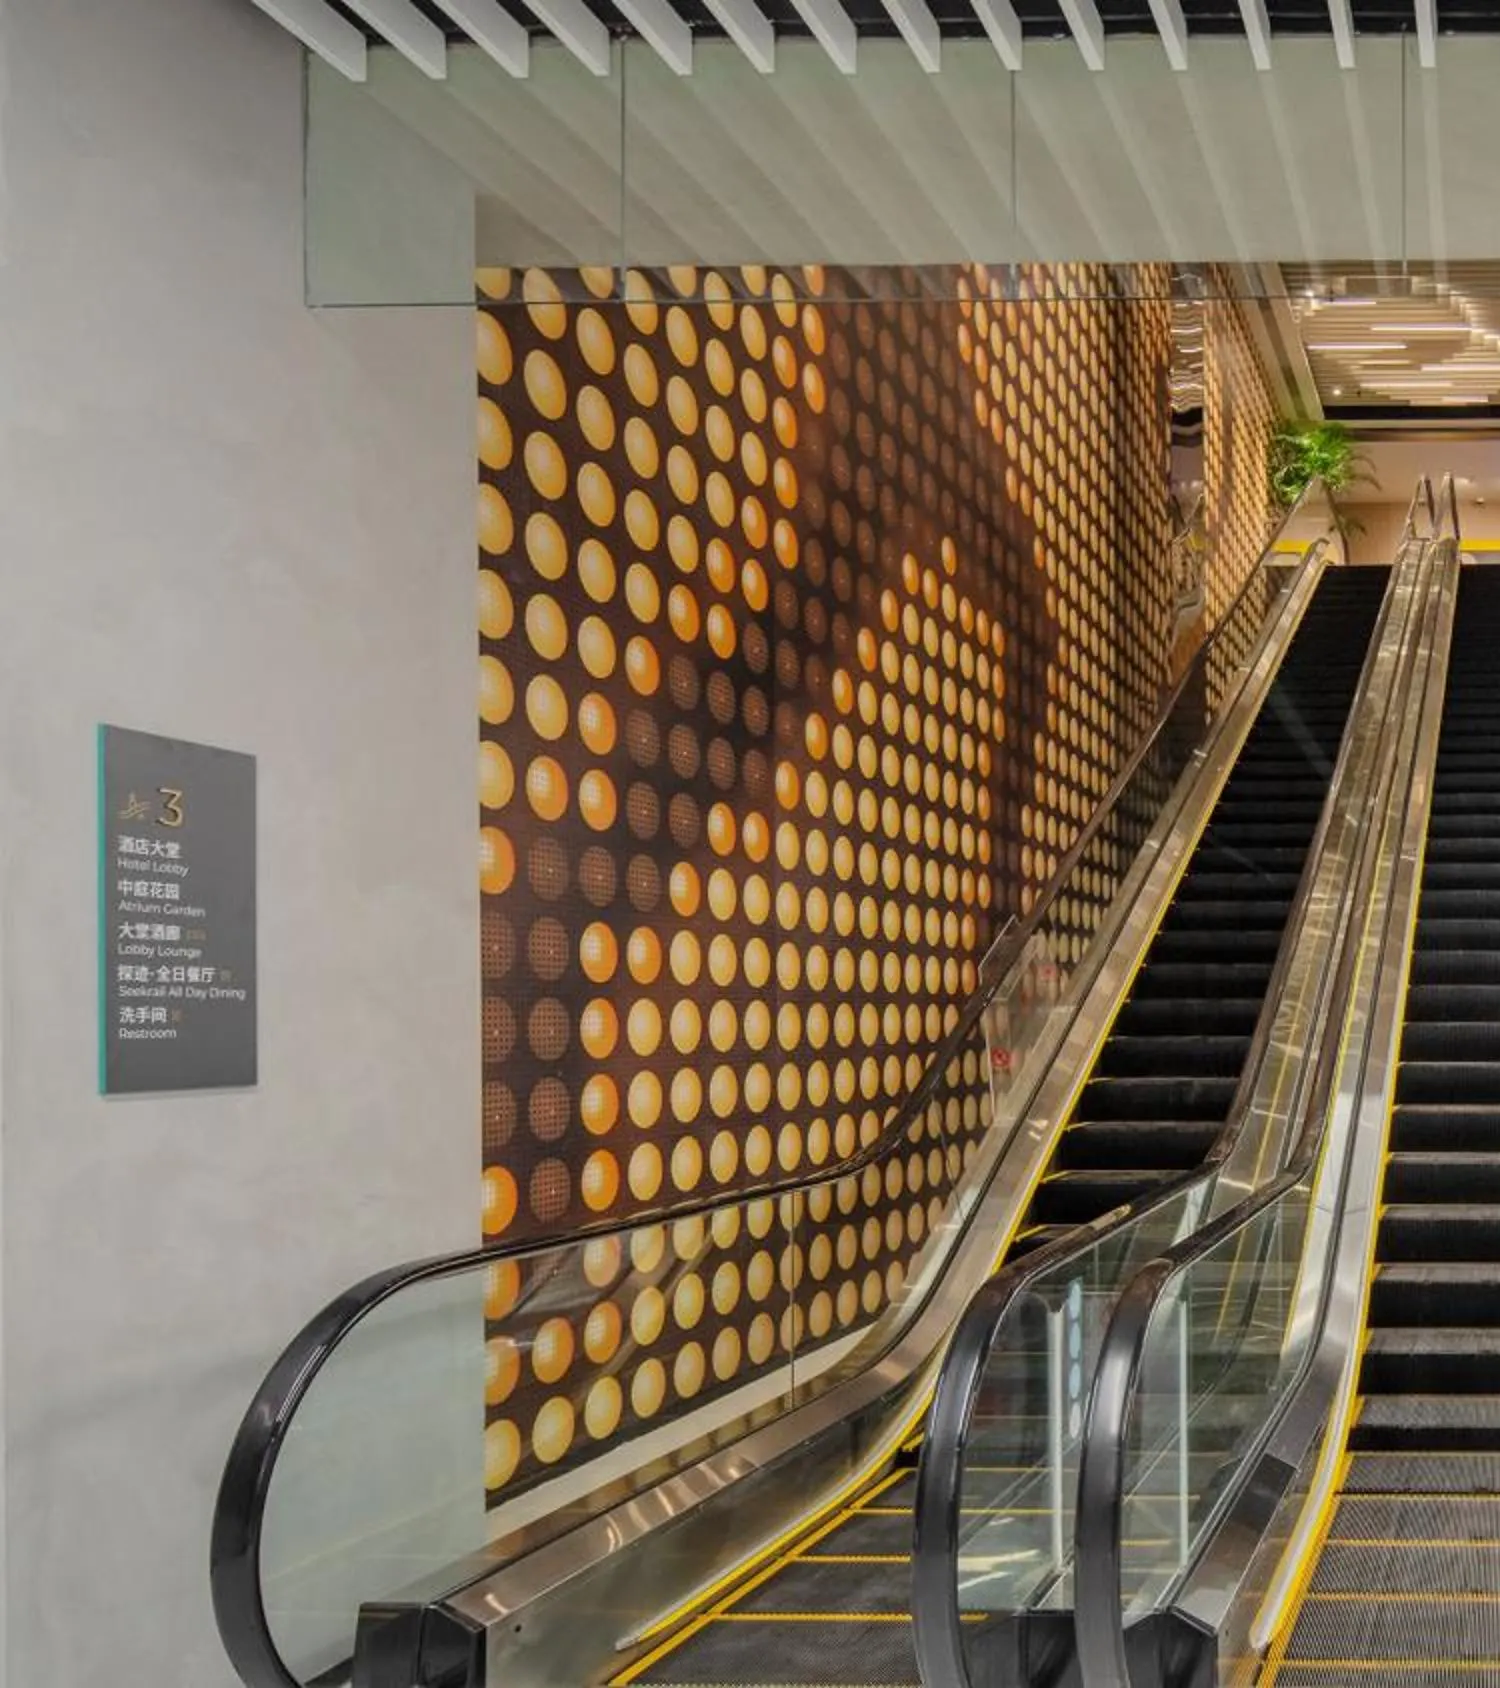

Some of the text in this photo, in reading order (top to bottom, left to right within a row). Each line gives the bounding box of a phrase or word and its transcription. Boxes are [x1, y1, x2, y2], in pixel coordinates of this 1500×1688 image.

[155, 788, 183, 827] 3
[118, 835, 181, 859] 酒店大堂
[117, 858, 190, 878] Hotel Lobby
[117, 880, 180, 900] 中庭花园
[118, 899, 206, 917] Atrium Garden
[118, 943, 202, 959] Lobby Lounge
[168, 985, 183, 998] All
[185, 987, 207, 1000] Day
[209, 987, 246, 1001] Dining
[119, 1005, 167, 1024] 洗手间
[119, 1027, 177, 1039] Restroom
